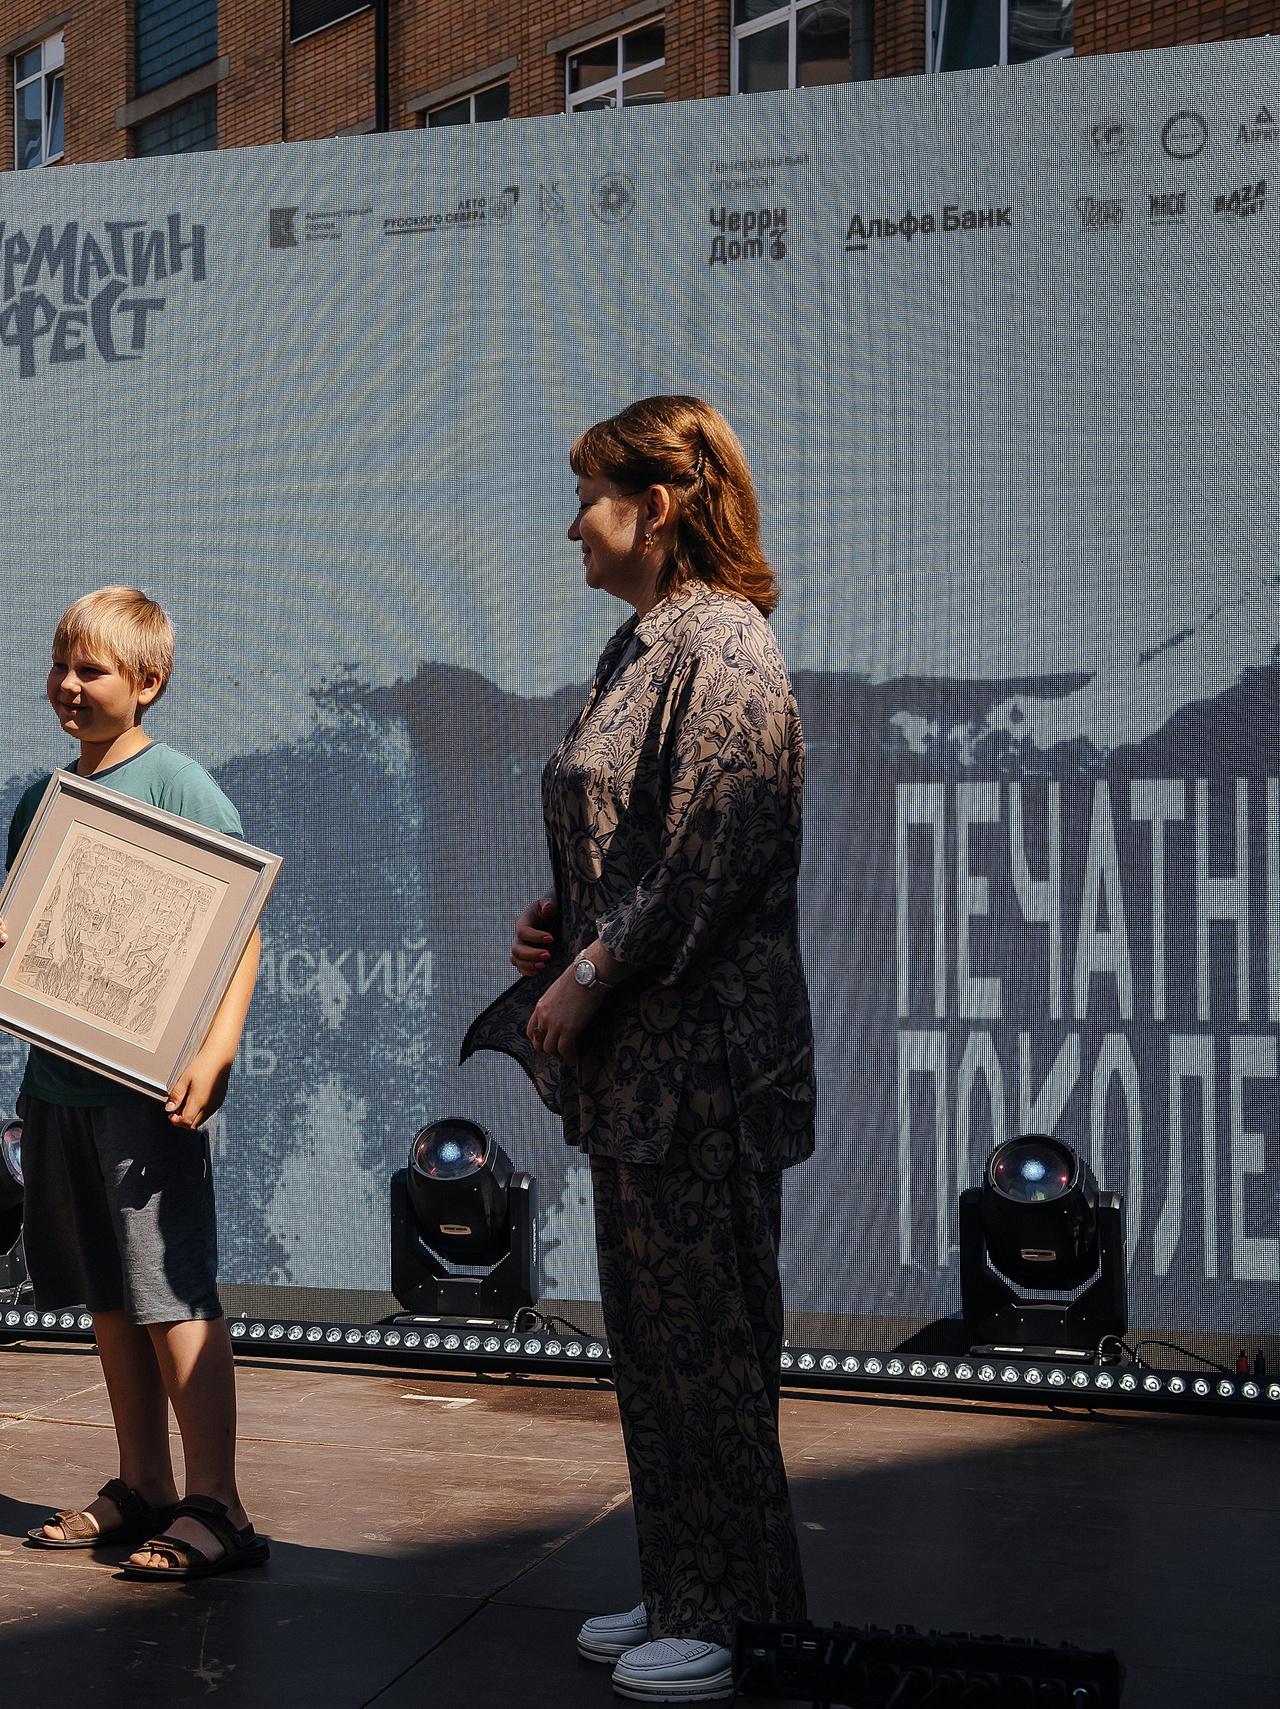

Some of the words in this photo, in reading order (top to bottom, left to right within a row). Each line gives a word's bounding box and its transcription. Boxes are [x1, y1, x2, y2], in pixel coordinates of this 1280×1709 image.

[709, 206, 787, 238] Черри
[845, 212, 936, 244] Альфа
[942, 204, 1013, 233] Банк
[896, 777, 1280, 1021] ПЕЧАТН
